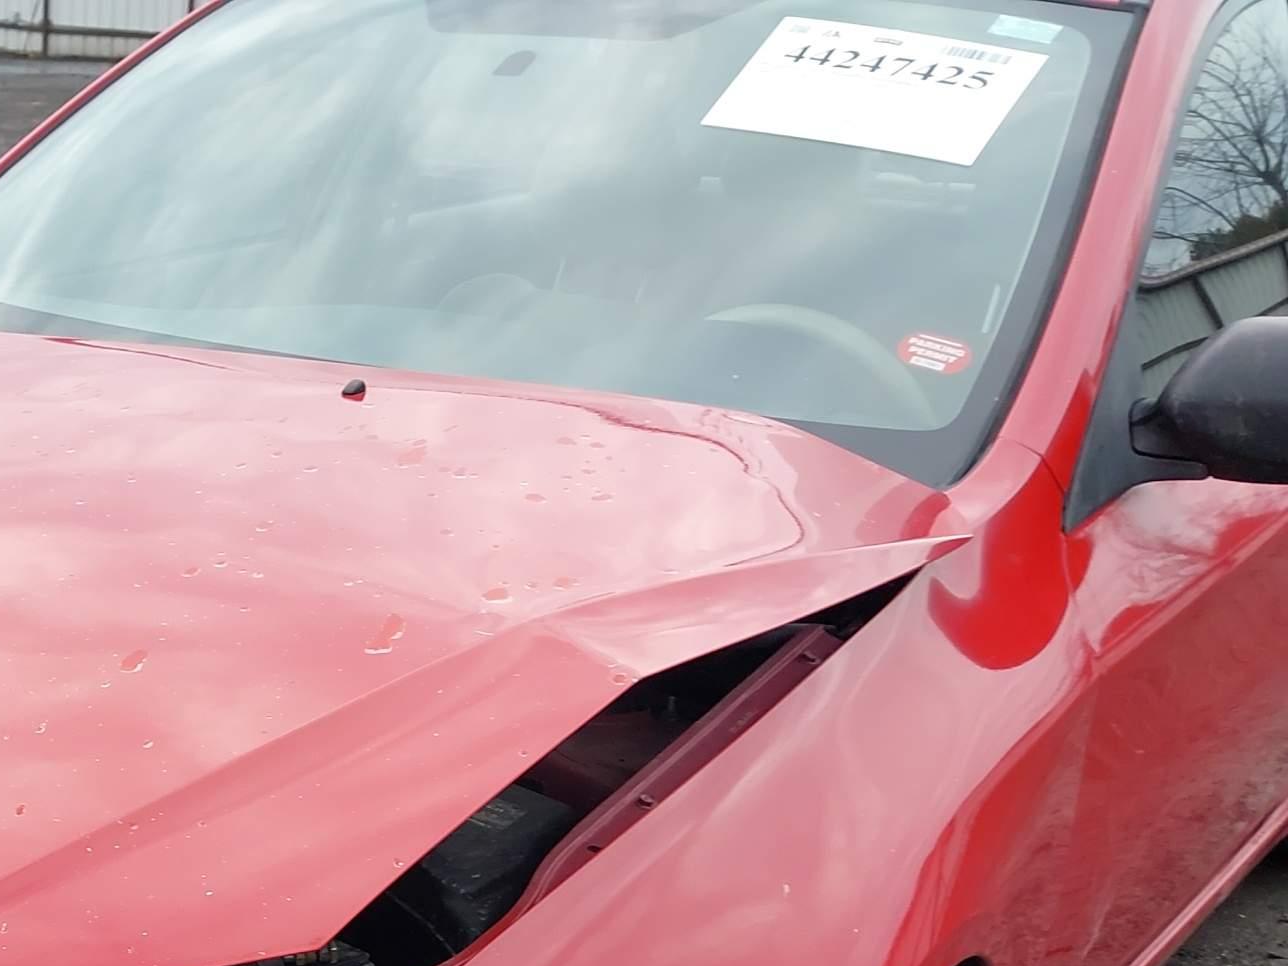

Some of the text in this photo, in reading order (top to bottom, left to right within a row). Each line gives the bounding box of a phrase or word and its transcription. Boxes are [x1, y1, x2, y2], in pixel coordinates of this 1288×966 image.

[784, 44, 996, 90] 44247425
[907, 345, 959, 364] PERMIT
[908, 336, 967, 358] PARKING
